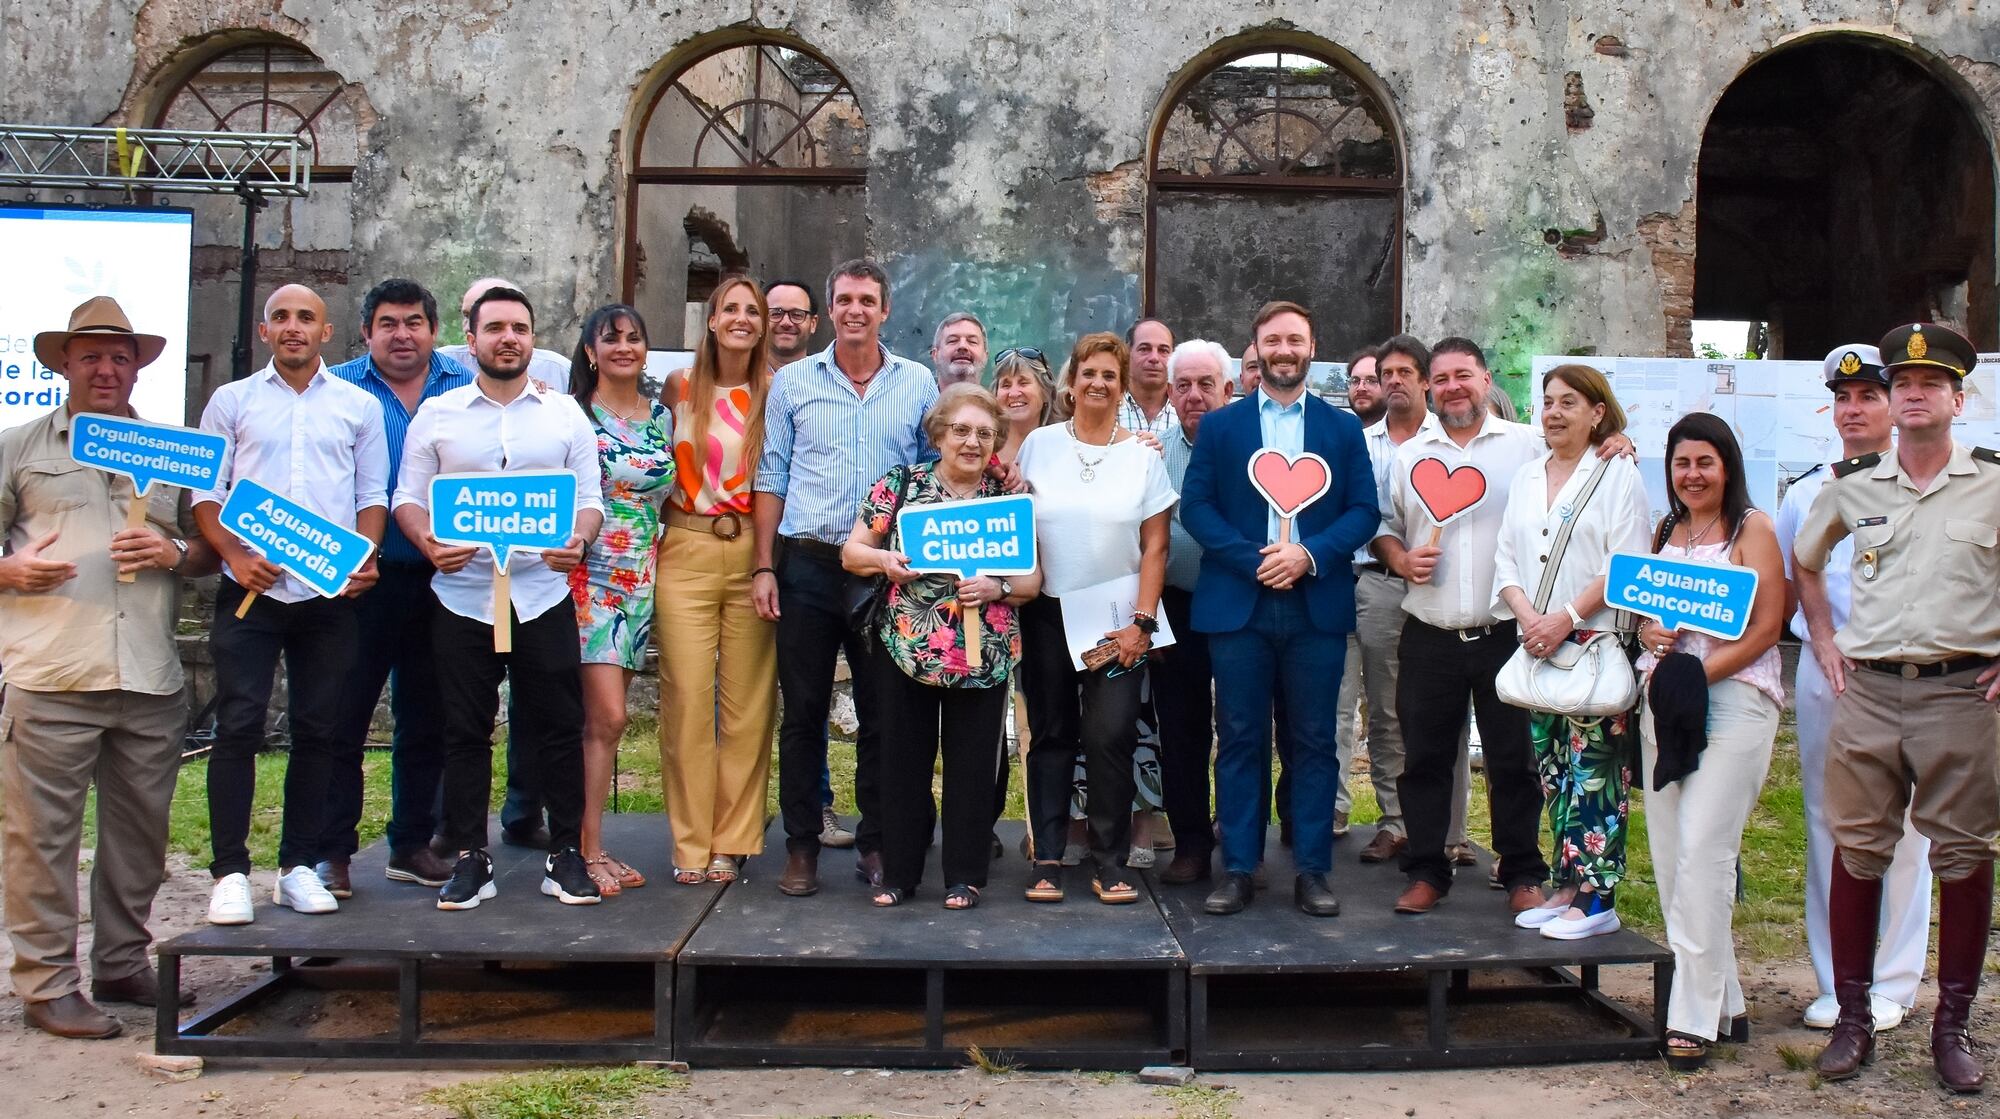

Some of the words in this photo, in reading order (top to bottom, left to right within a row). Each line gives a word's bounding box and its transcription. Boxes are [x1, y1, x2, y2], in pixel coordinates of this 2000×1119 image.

[87, 423, 215, 459] Orgullosamente
[83, 442, 212, 479] Concordiense
[455, 487, 517, 506] Amo
[525, 489, 556, 508] mi
[257, 498, 342, 556] Aguante
[454, 511, 556, 534] Ciudad
[922, 517, 979, 536] Amo
[987, 513, 1016, 532] mi
[237, 512, 338, 581] Concordia
[923, 536, 1019, 561] Ciudad
[1636, 564, 1729, 597] Aguante
[1623, 585, 1734, 623] Concordia
